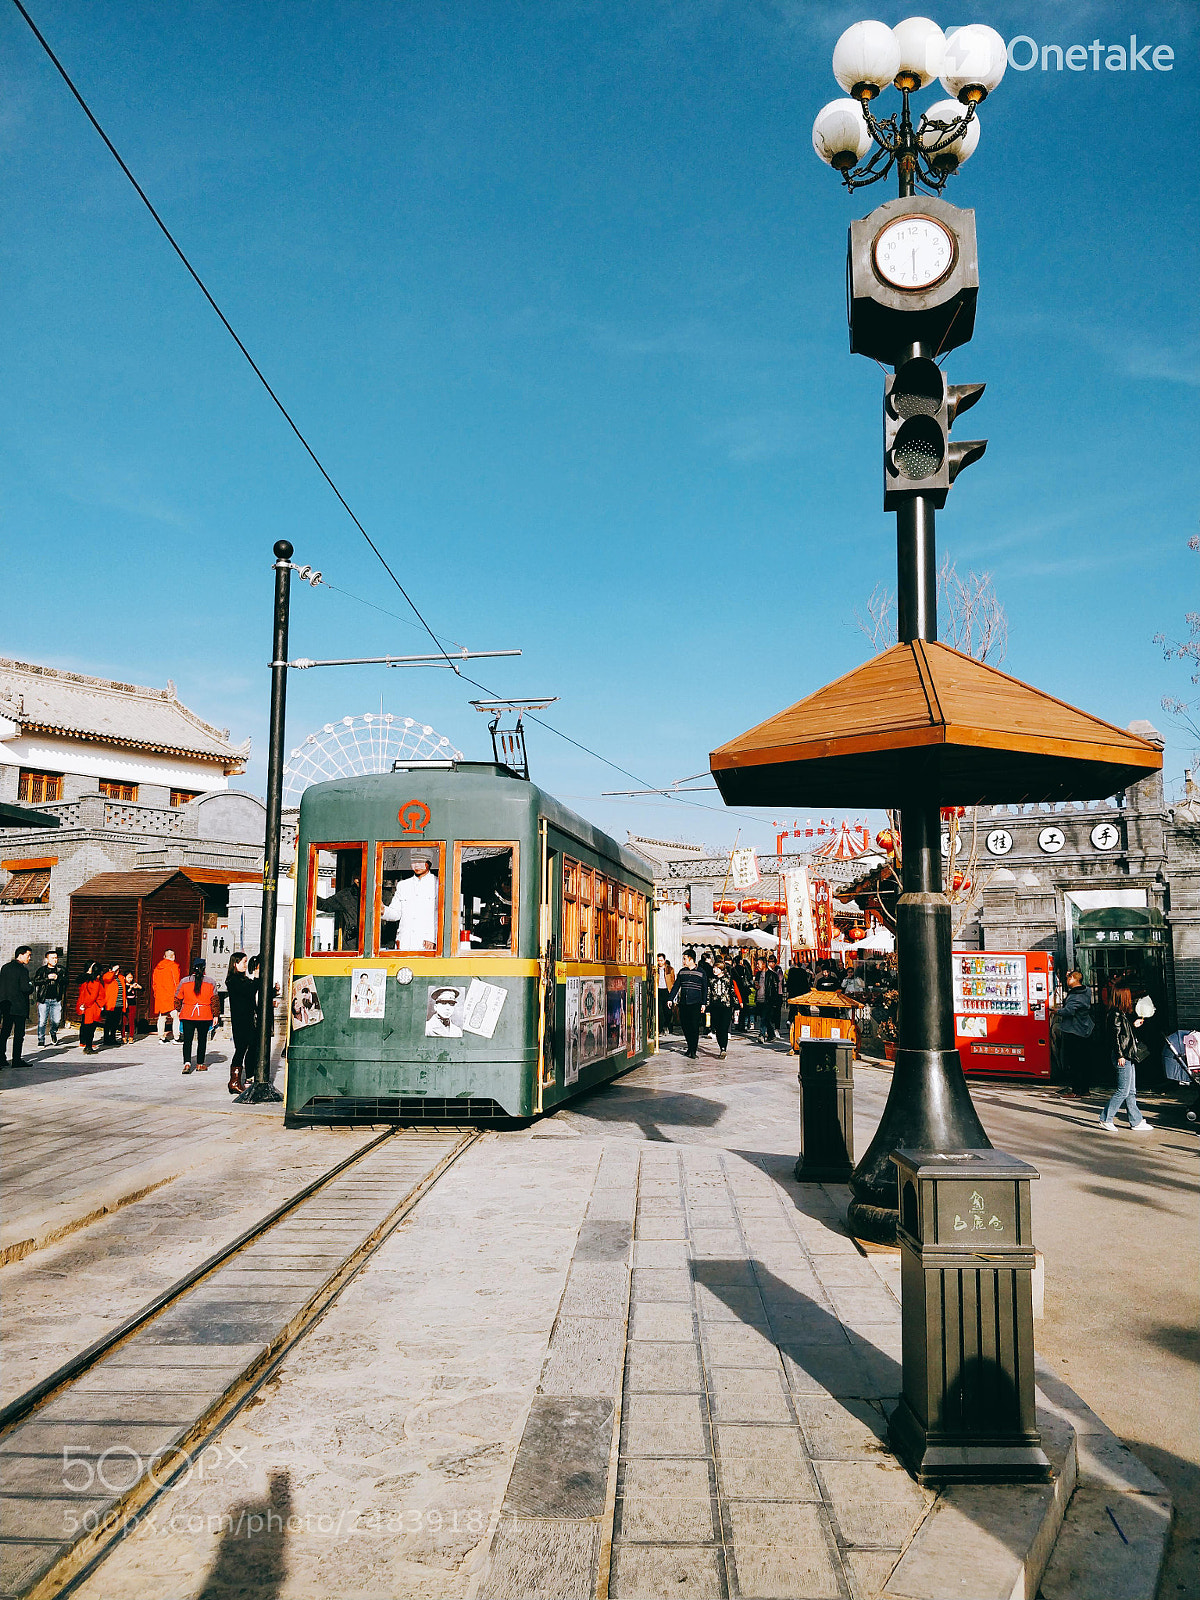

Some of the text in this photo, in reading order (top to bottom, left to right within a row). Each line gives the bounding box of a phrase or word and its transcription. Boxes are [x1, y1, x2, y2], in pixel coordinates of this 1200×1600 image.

[907, 226, 918, 235] 12
[923, 228, 929, 238] 1
[897, 231, 905, 240] 11
[887, 241, 897, 250] 10
[932, 237, 940, 246] 2
[937, 246, 945, 256] 3
[883, 252, 890, 261] 9
[889, 264, 896, 273] 8
[934, 260, 941, 268] 4
[899, 272, 906, 281] 7
[911, 273, 918, 282] 6
[924, 270, 931, 279] 5
